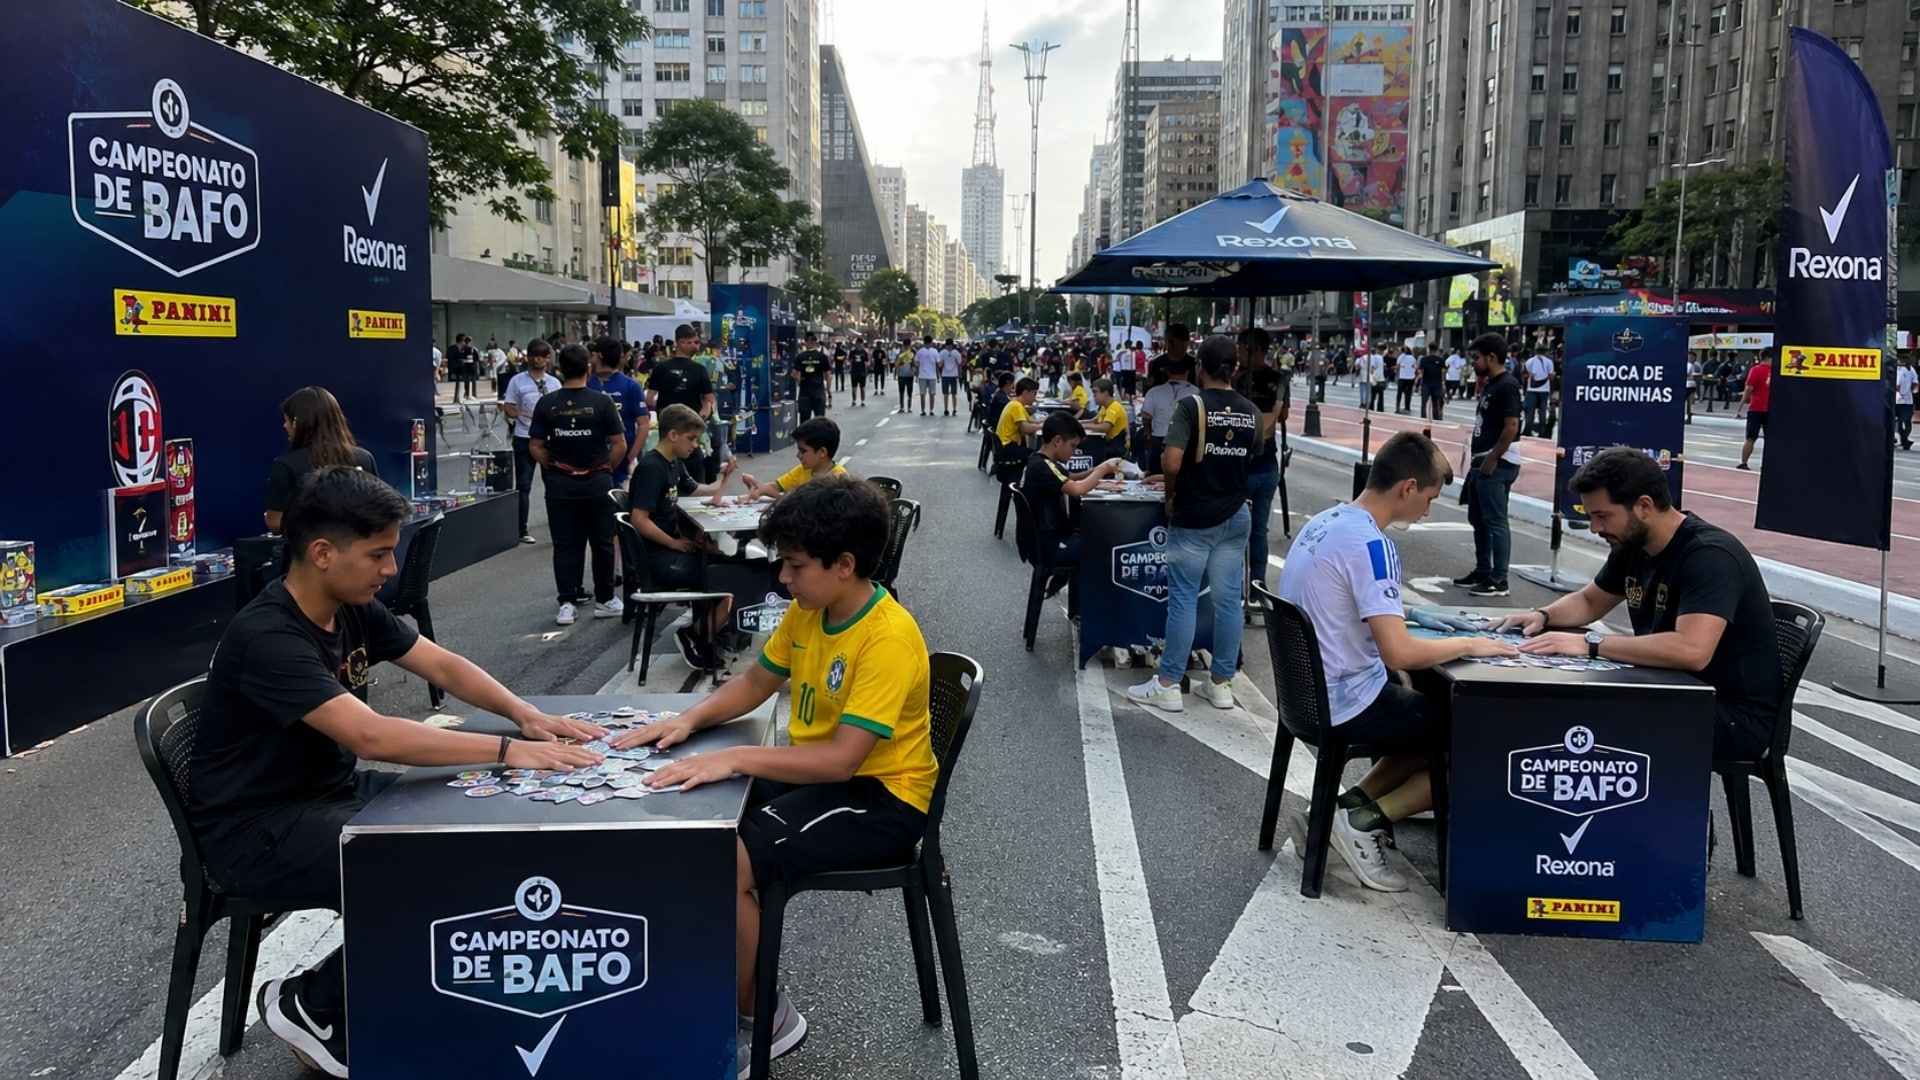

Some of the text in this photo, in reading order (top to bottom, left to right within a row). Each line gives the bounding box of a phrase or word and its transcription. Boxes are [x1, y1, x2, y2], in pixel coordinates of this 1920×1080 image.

[89, 136, 246, 190] CAMPEONATO
[94, 172, 249, 244] DE BAFO
[343, 224, 406, 271] Rexona
[1216, 235, 1357, 251] Rexona
[1789, 248, 1881, 281] Rexona
[151, 299, 232, 323] PANINI
[365, 315, 403, 331] PANINI
[1813, 353, 1877, 369] PANINI
[1587, 365, 1663, 381] TROCA DE
[1576, 386, 1672, 402] FIGURINHAS
[797, 682, 815, 726] 10
[1520, 758, 1638, 774] CAMPEONATO
[1521, 774, 1638, 801] DE BAFO
[1536, 855, 1614, 877] Rexona
[1552, 902, 1616, 914] PANINI
[450, 928, 629, 951] CAMPEONATO
[453, 952, 631, 994] DE BAFO
